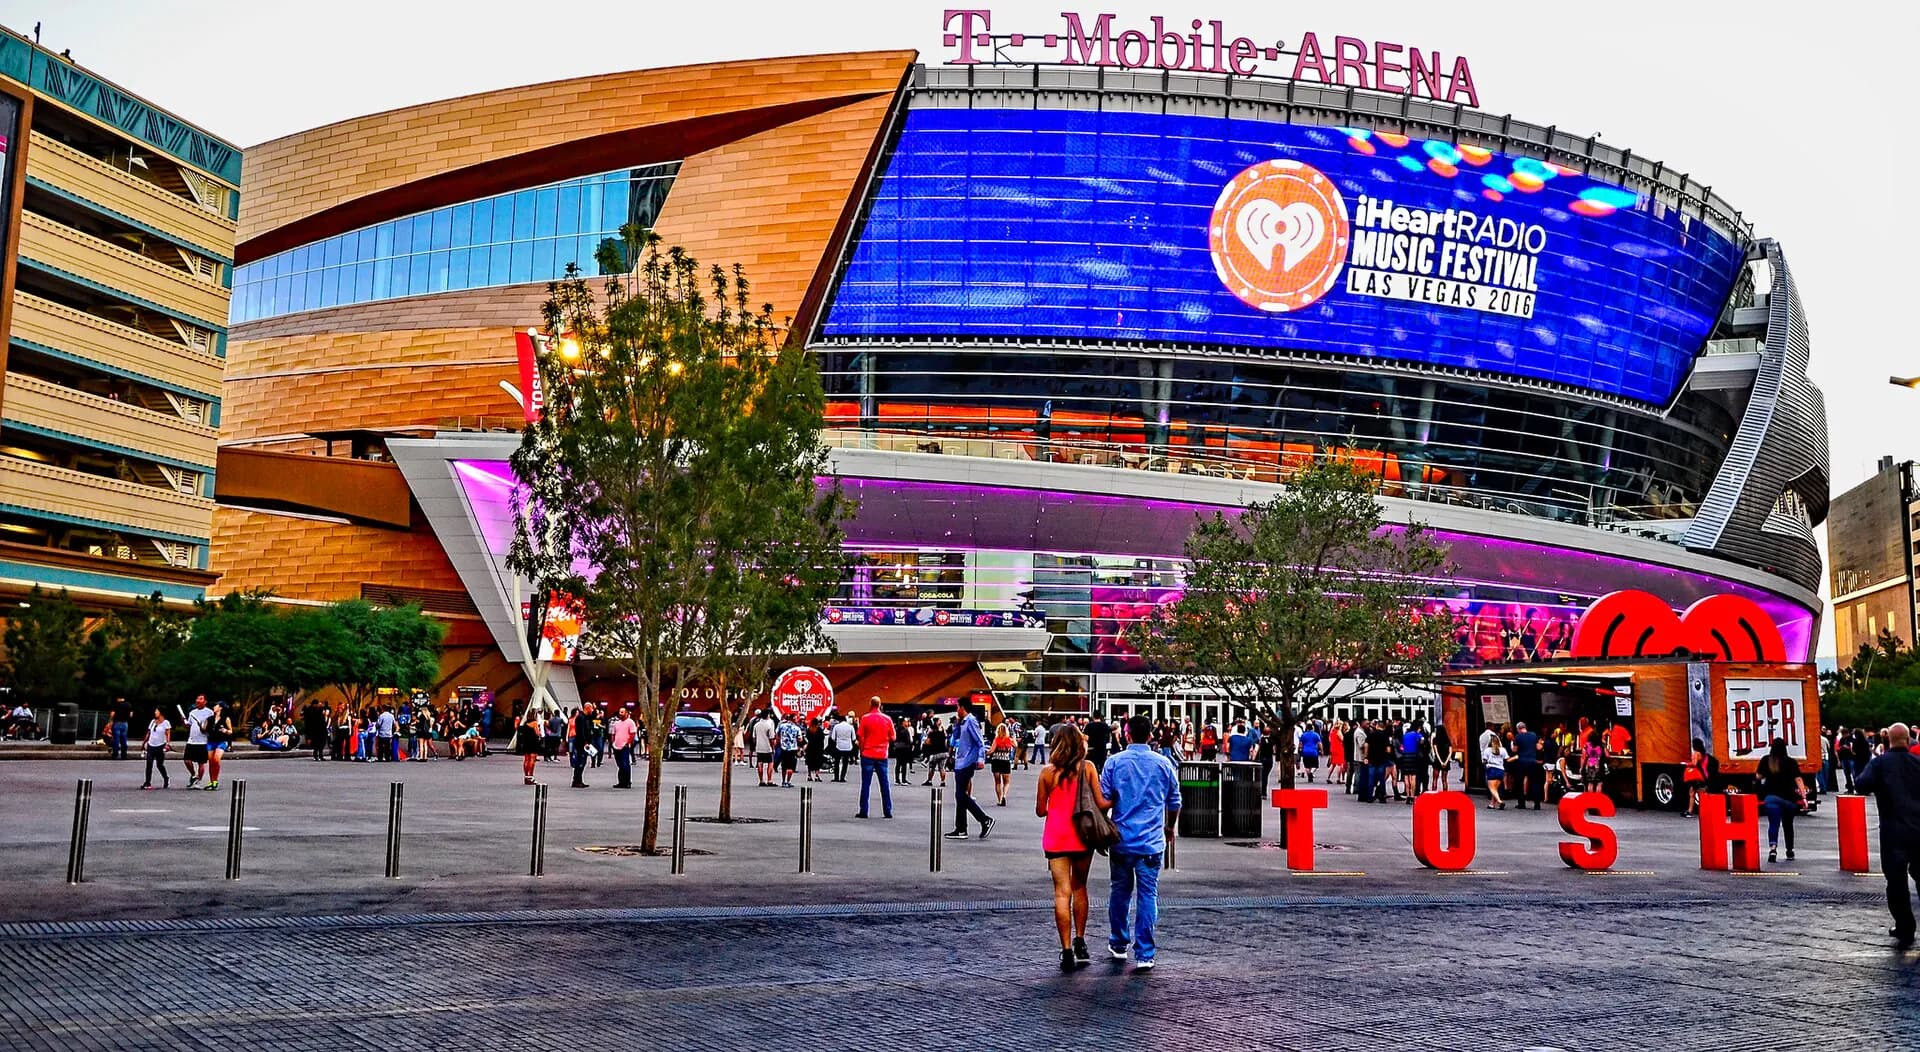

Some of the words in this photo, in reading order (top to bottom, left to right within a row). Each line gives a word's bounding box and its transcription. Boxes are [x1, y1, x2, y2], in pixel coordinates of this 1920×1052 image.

[1292, 31, 1480, 108] ARENA
[1354, 194, 1546, 255] iHeartRADIO
[1351, 229, 1435, 275] MUSIC
[1438, 240, 1538, 292] FESTIVAL
[1350, 270, 1393, 296] LAS
[1408, 276, 1477, 307] VEGAS
[1488, 289, 1532, 316] 2016
[1732, 698, 1799, 756] BEER
